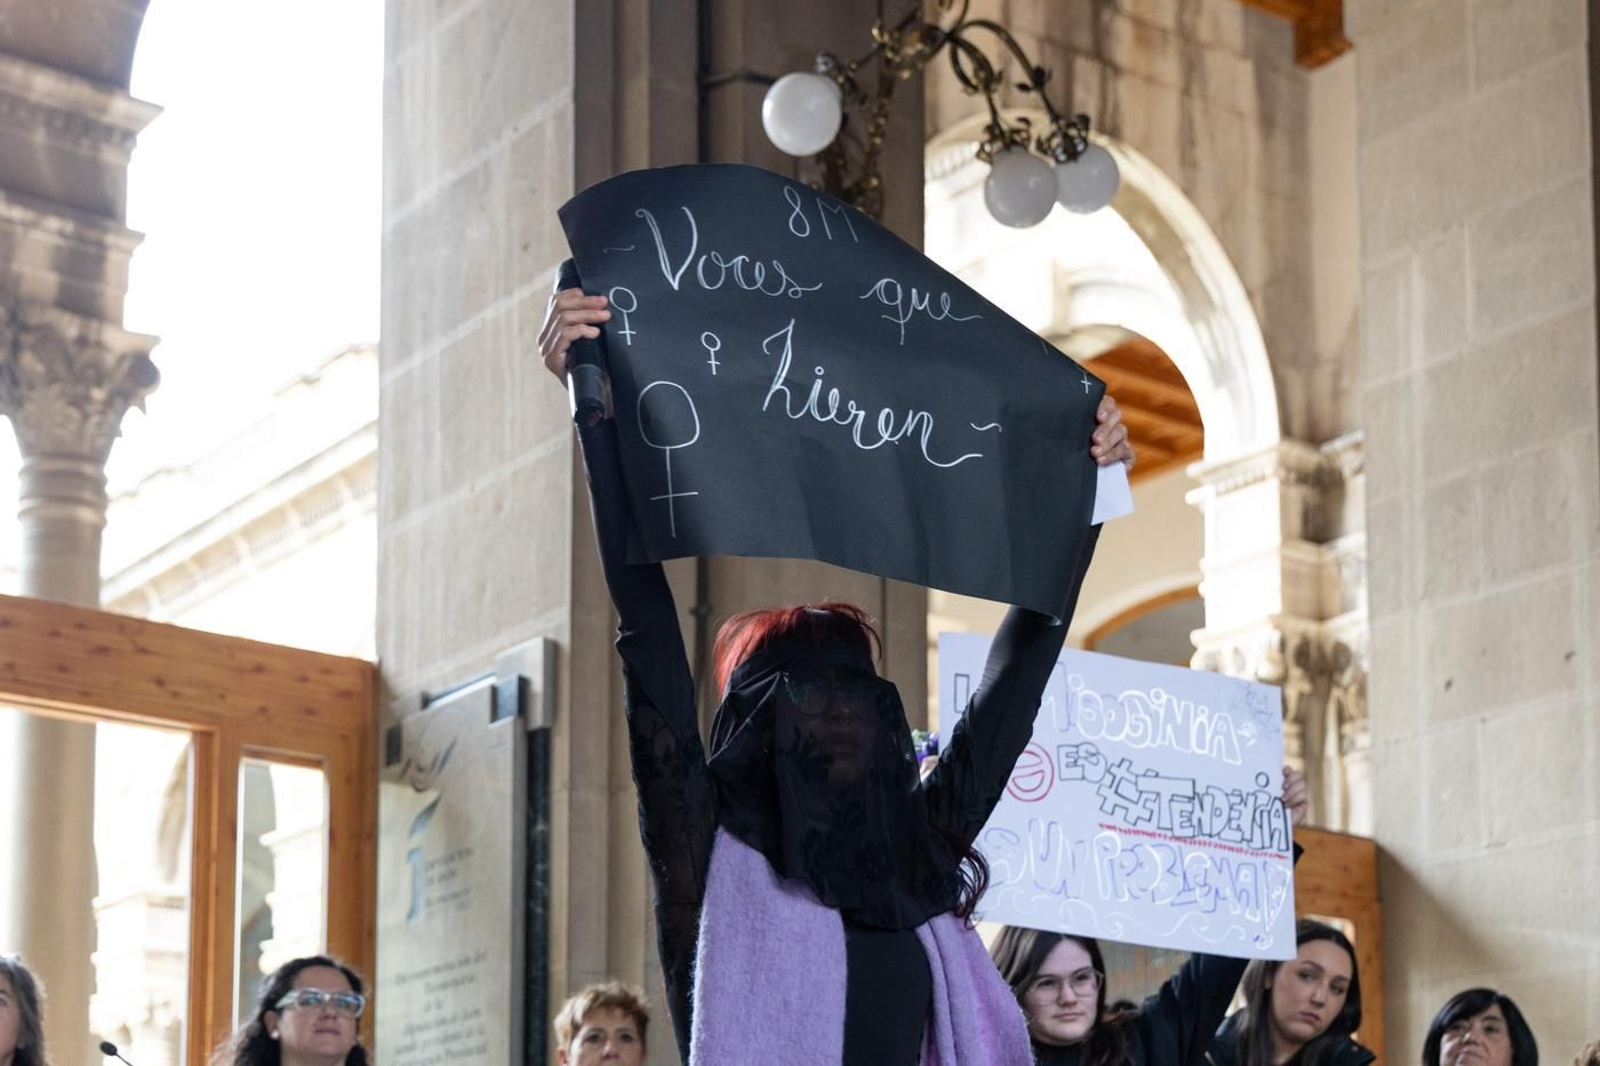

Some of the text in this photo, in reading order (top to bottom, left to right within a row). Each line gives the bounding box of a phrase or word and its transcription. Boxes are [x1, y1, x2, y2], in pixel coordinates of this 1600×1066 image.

[783, 184, 859, 243] 8M
[635, 205, 983, 346] Voces que
